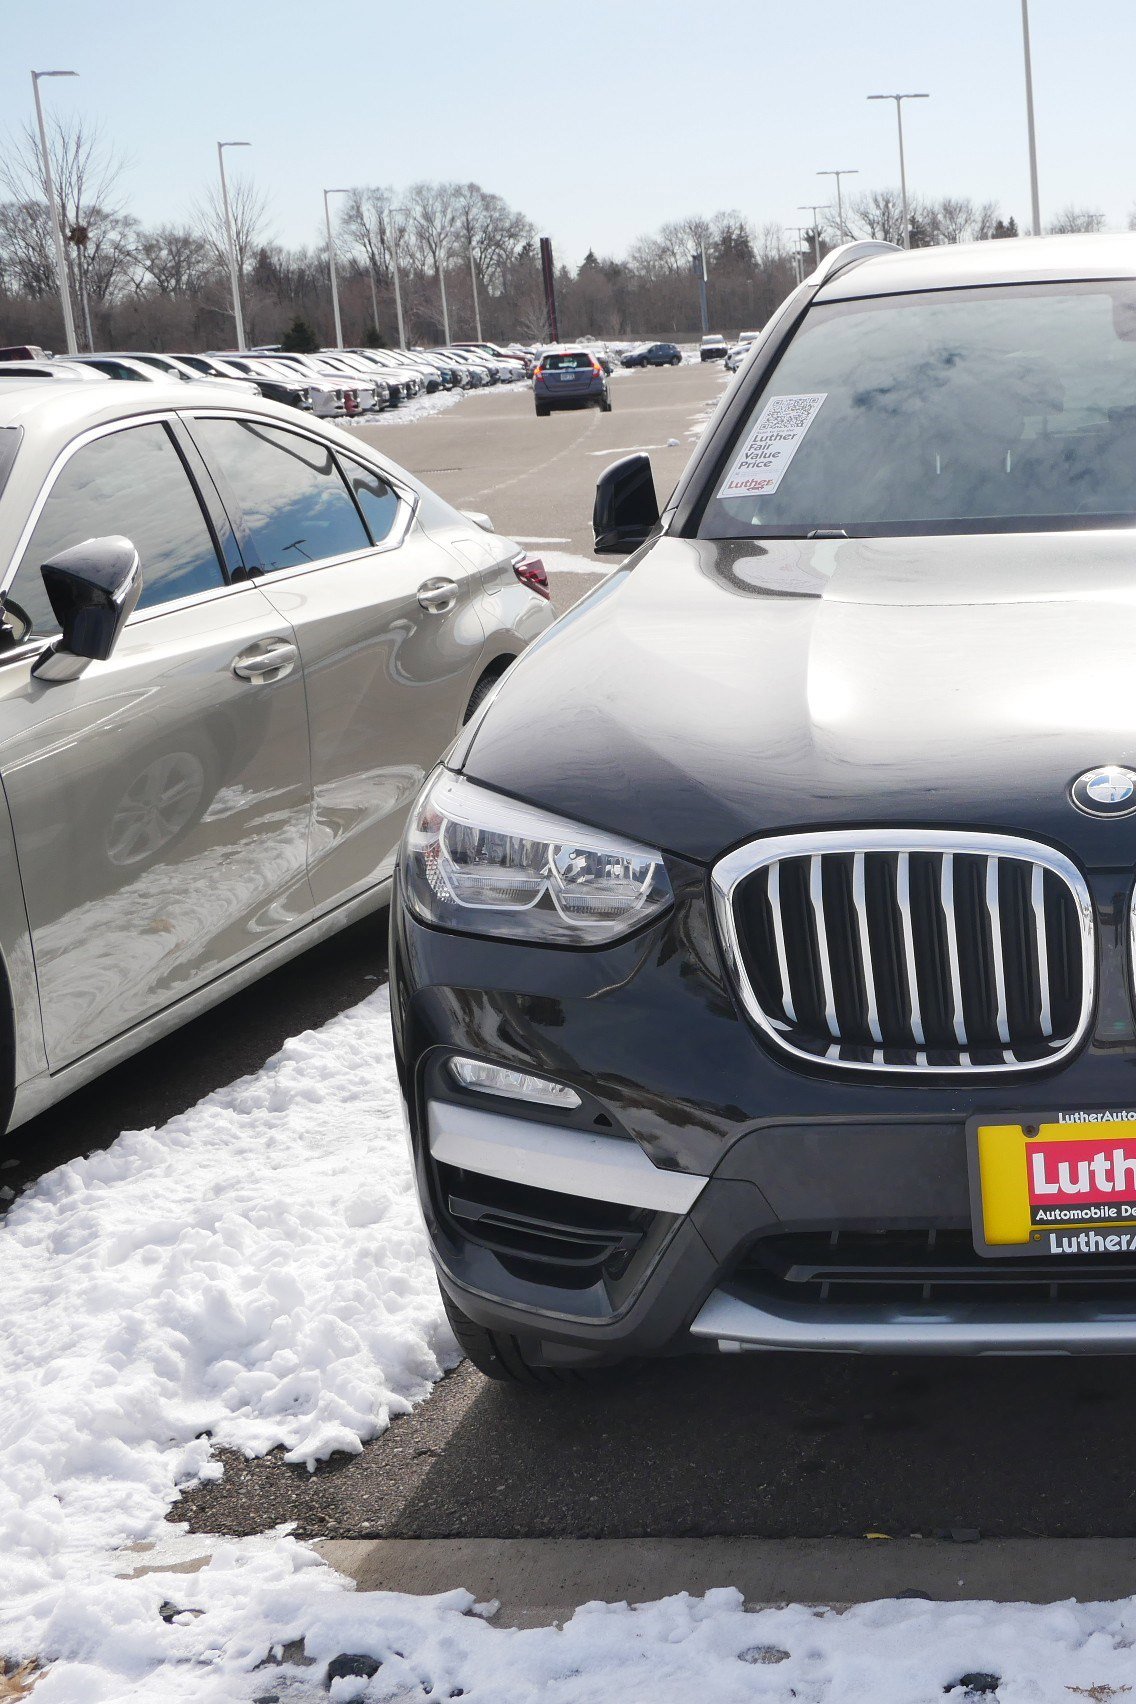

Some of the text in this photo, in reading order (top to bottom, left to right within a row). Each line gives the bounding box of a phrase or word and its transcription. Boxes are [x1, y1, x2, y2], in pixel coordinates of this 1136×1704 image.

[752, 433, 798, 443] Luther
[748, 442, 773, 451] Fair
[745, 451, 781, 460] Value
[738, 460, 773, 469] Price
[727, 478, 773, 489] Luther
[1035, 1205, 1118, 1220] Automobile
